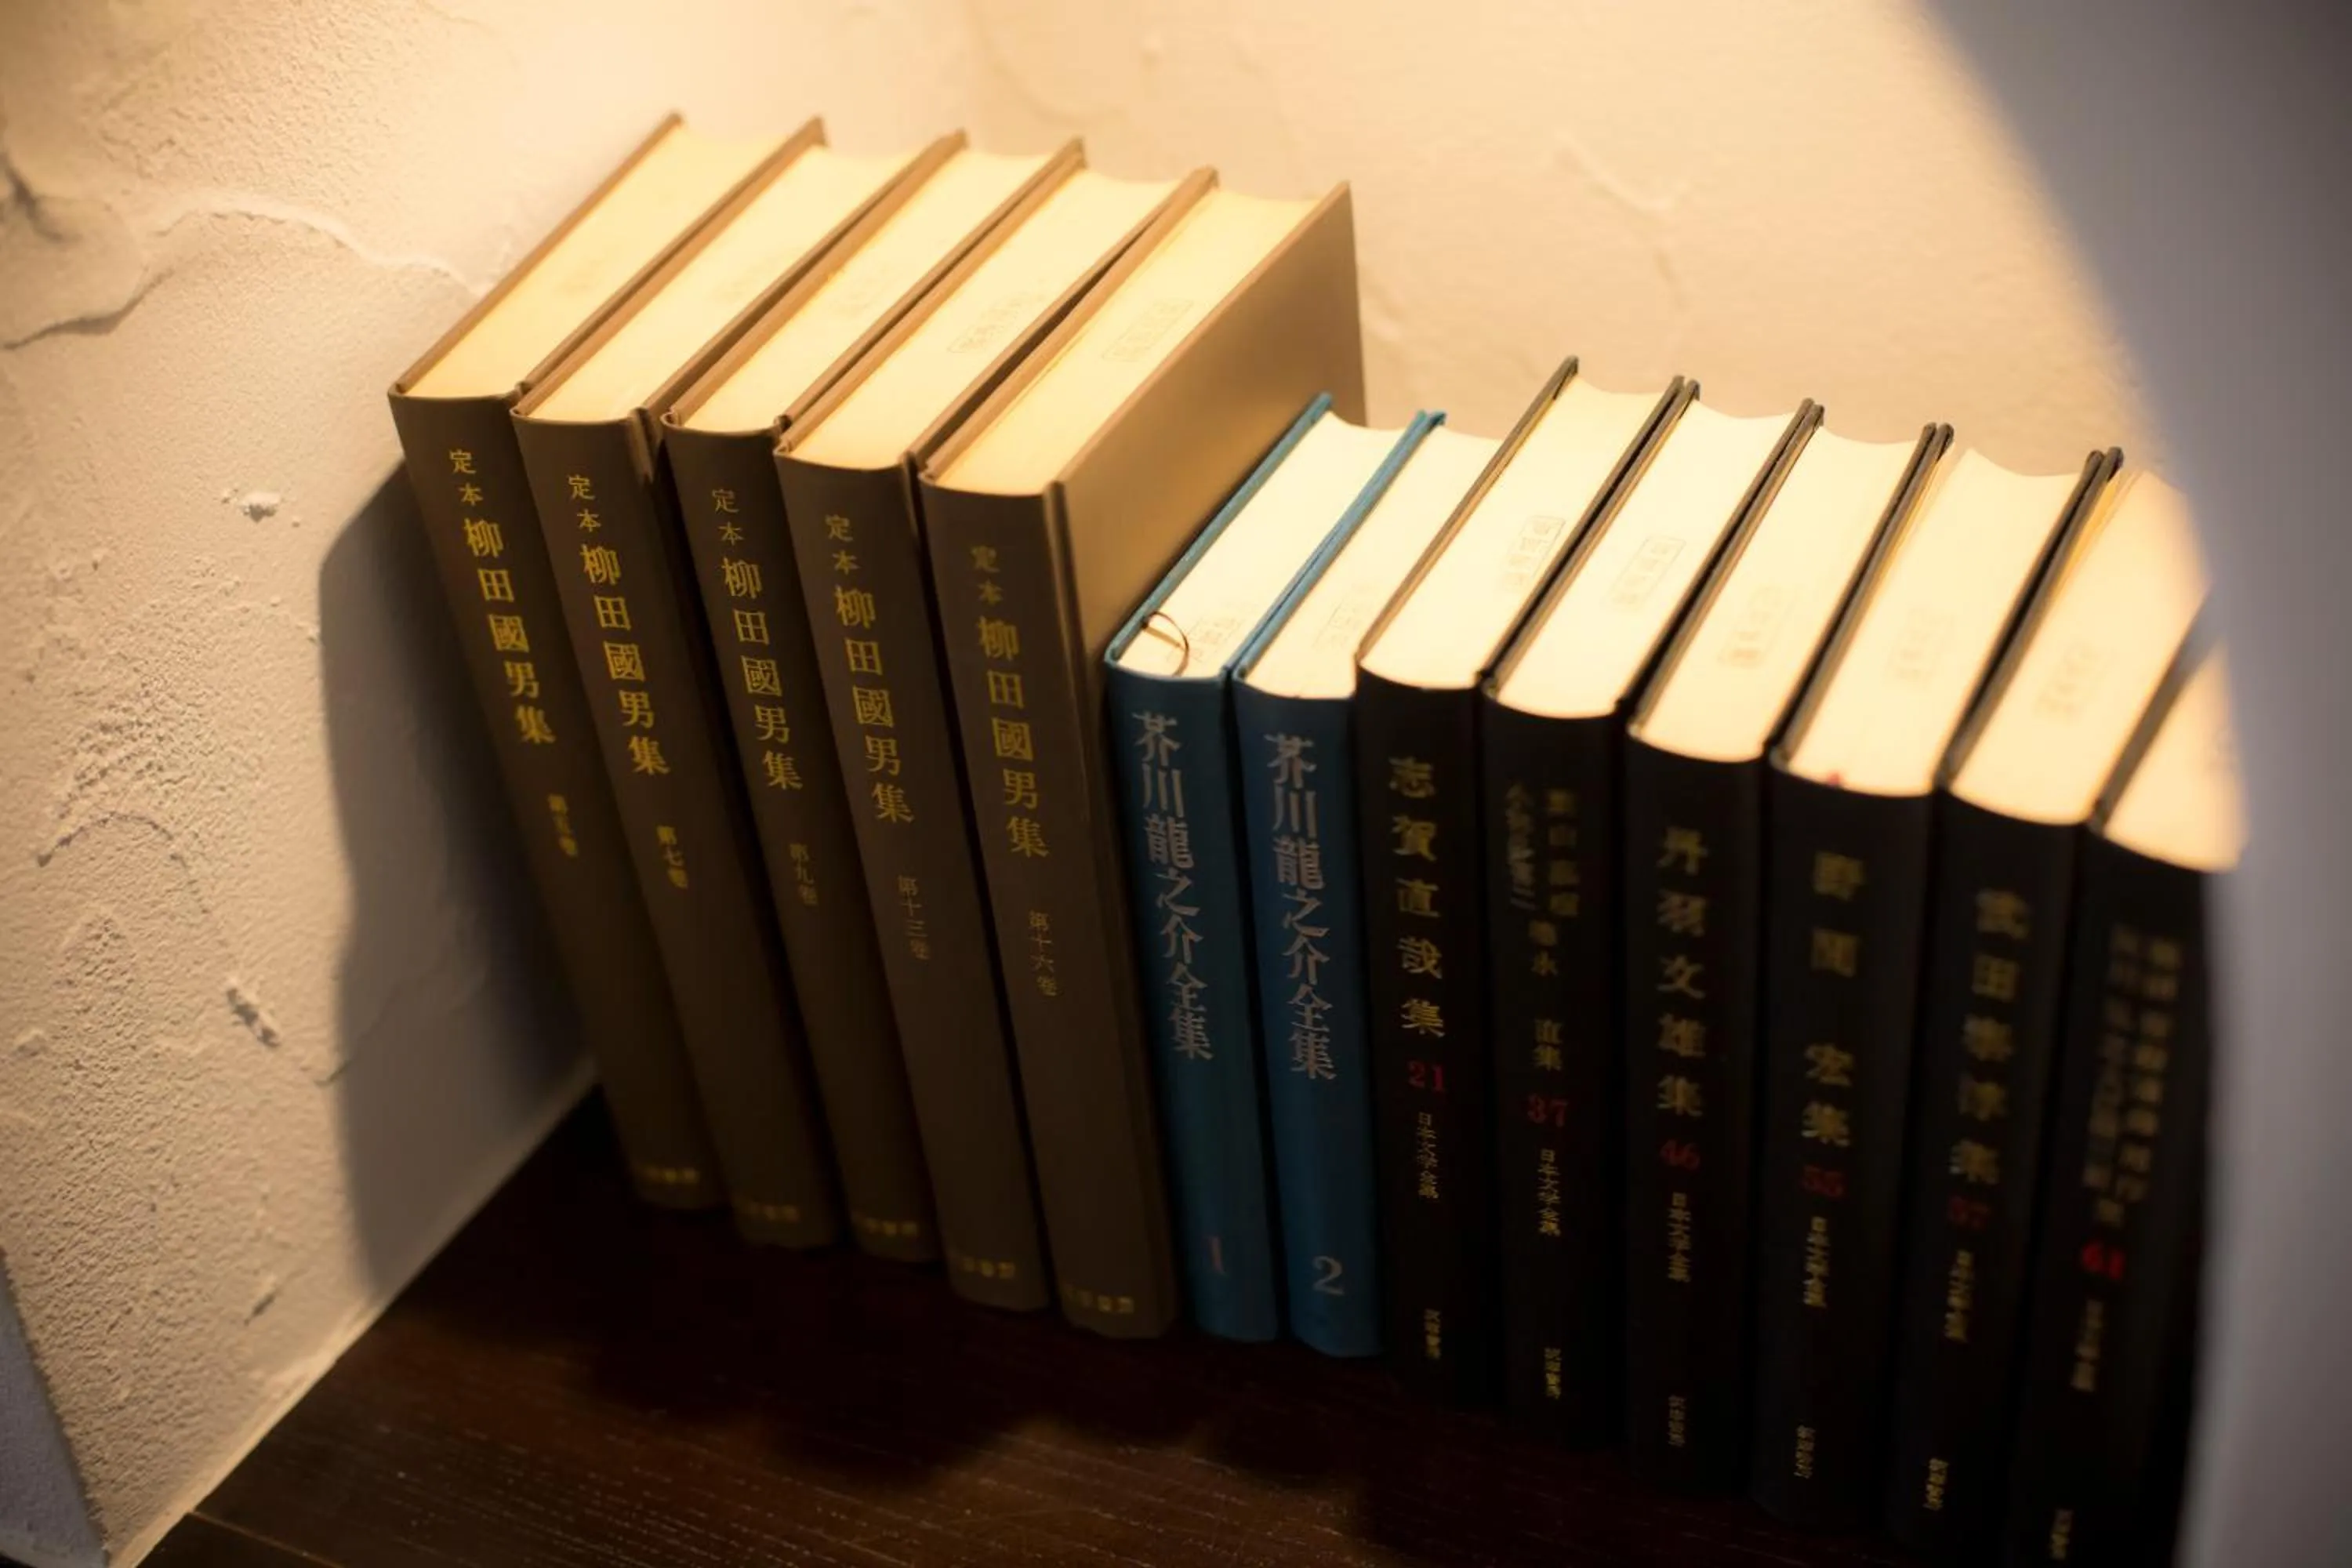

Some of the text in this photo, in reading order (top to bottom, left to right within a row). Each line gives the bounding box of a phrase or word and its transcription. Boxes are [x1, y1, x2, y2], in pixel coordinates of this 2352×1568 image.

[448, 448, 555, 744] 定本柳田國男集
[568, 474, 671, 775] 定本柳田國男集
[710, 488, 803, 791] 定本柳田國男集
[825, 514, 914, 824] 定本柳田國男集
[1131, 710, 1215, 1061] 芥川龍之介全集
[1262, 731, 1338, 1080] 芥川龍之介全集
[1388, 755, 1446, 1038] 志賀直哉集
[1406, 1059, 1447, 1095] 21
[1526, 1092, 1570, 1128] 37
[1658, 1138, 1701, 1171] 46
[1204, 1233, 1229, 1277] 1
[1311, 1254, 1346, 1297] 2
